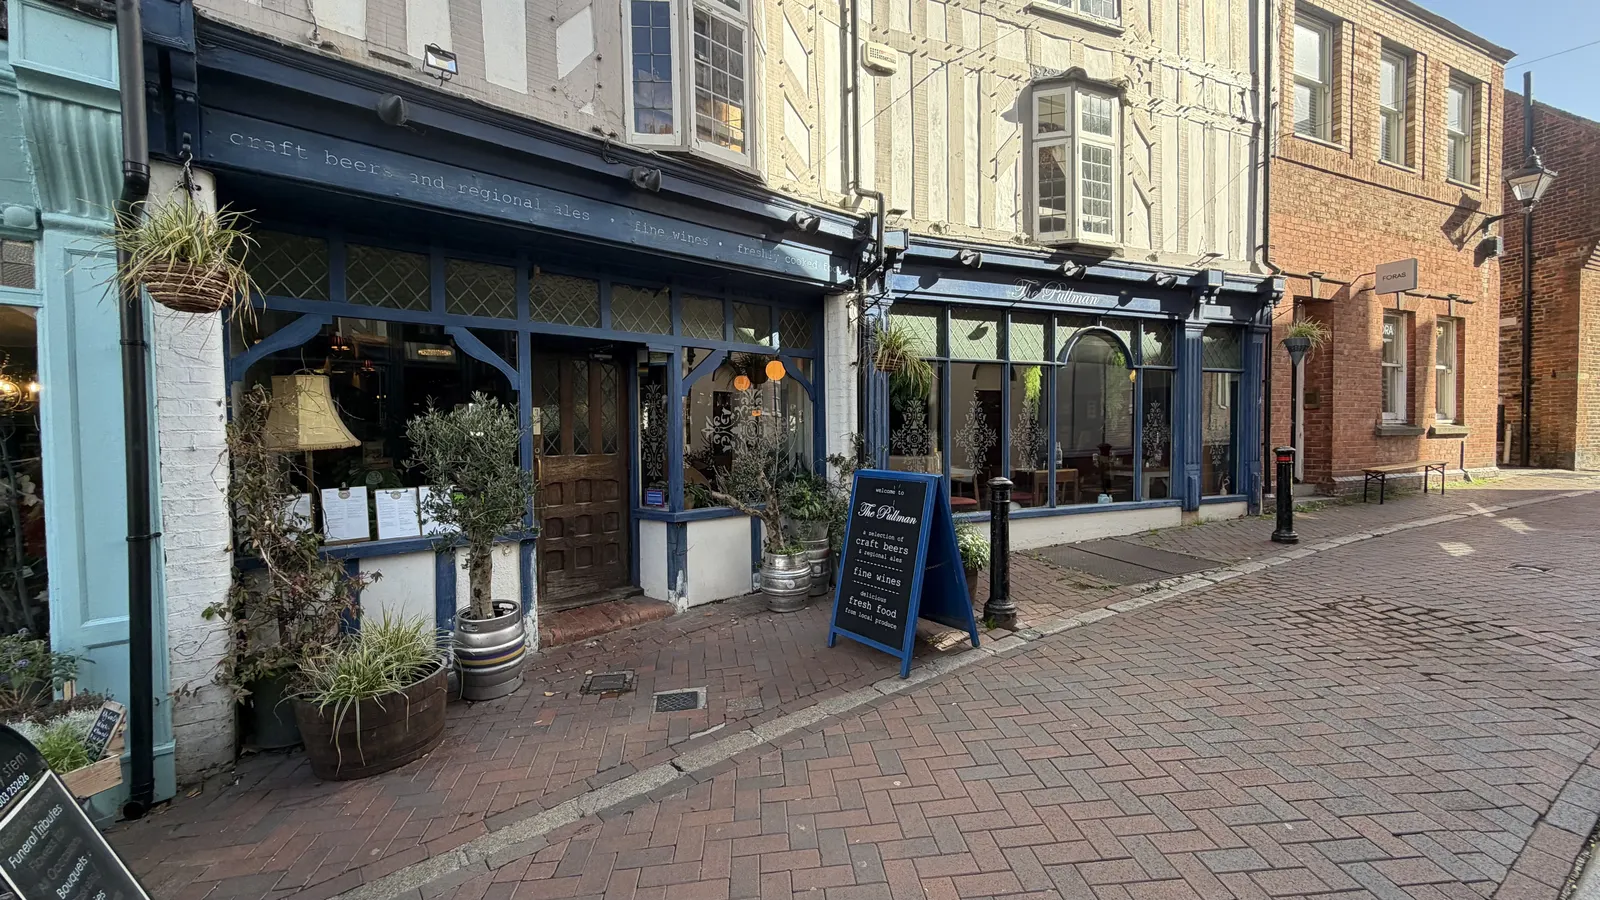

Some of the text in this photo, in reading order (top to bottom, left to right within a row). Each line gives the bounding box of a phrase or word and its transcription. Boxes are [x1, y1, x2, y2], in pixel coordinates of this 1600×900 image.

[230, 133, 308, 160] craft
[325, 150, 393, 178] beers
[410, 172, 445, 190] and
[458, 182, 541, 211] regional
[555, 204, 590, 221] ales
[633, 220, 665, 237] fine
[672, 227, 709, 246] wines
[737, 243, 780, 263] freshly
[784, 255, 818, 270] cooked
[1382, 271, 1407, 281] FORAS
[1011, 277, 1100, 305] The Pullman
[875, 487, 905, 496] welcome to
[857, 501, 918, 525] The Pullman
[855, 537, 909, 555] craft beers
[868, 531, 895, 541] selection
[864, 550, 887, 560] regional
[889, 555, 903, 564] ales
[853, 566, 902, 587] fine wines
[848, 595, 897, 619] fresh food
[860, 590, 887, 603] delicious
[844, 606, 897, 630] from local produce
[2, 751, 28, 778] stem
[7, 772, 30, 797] 252626
[8, 803, 63, 869] Funeral Tributes
[56, 855, 89, 900] Bouquets
